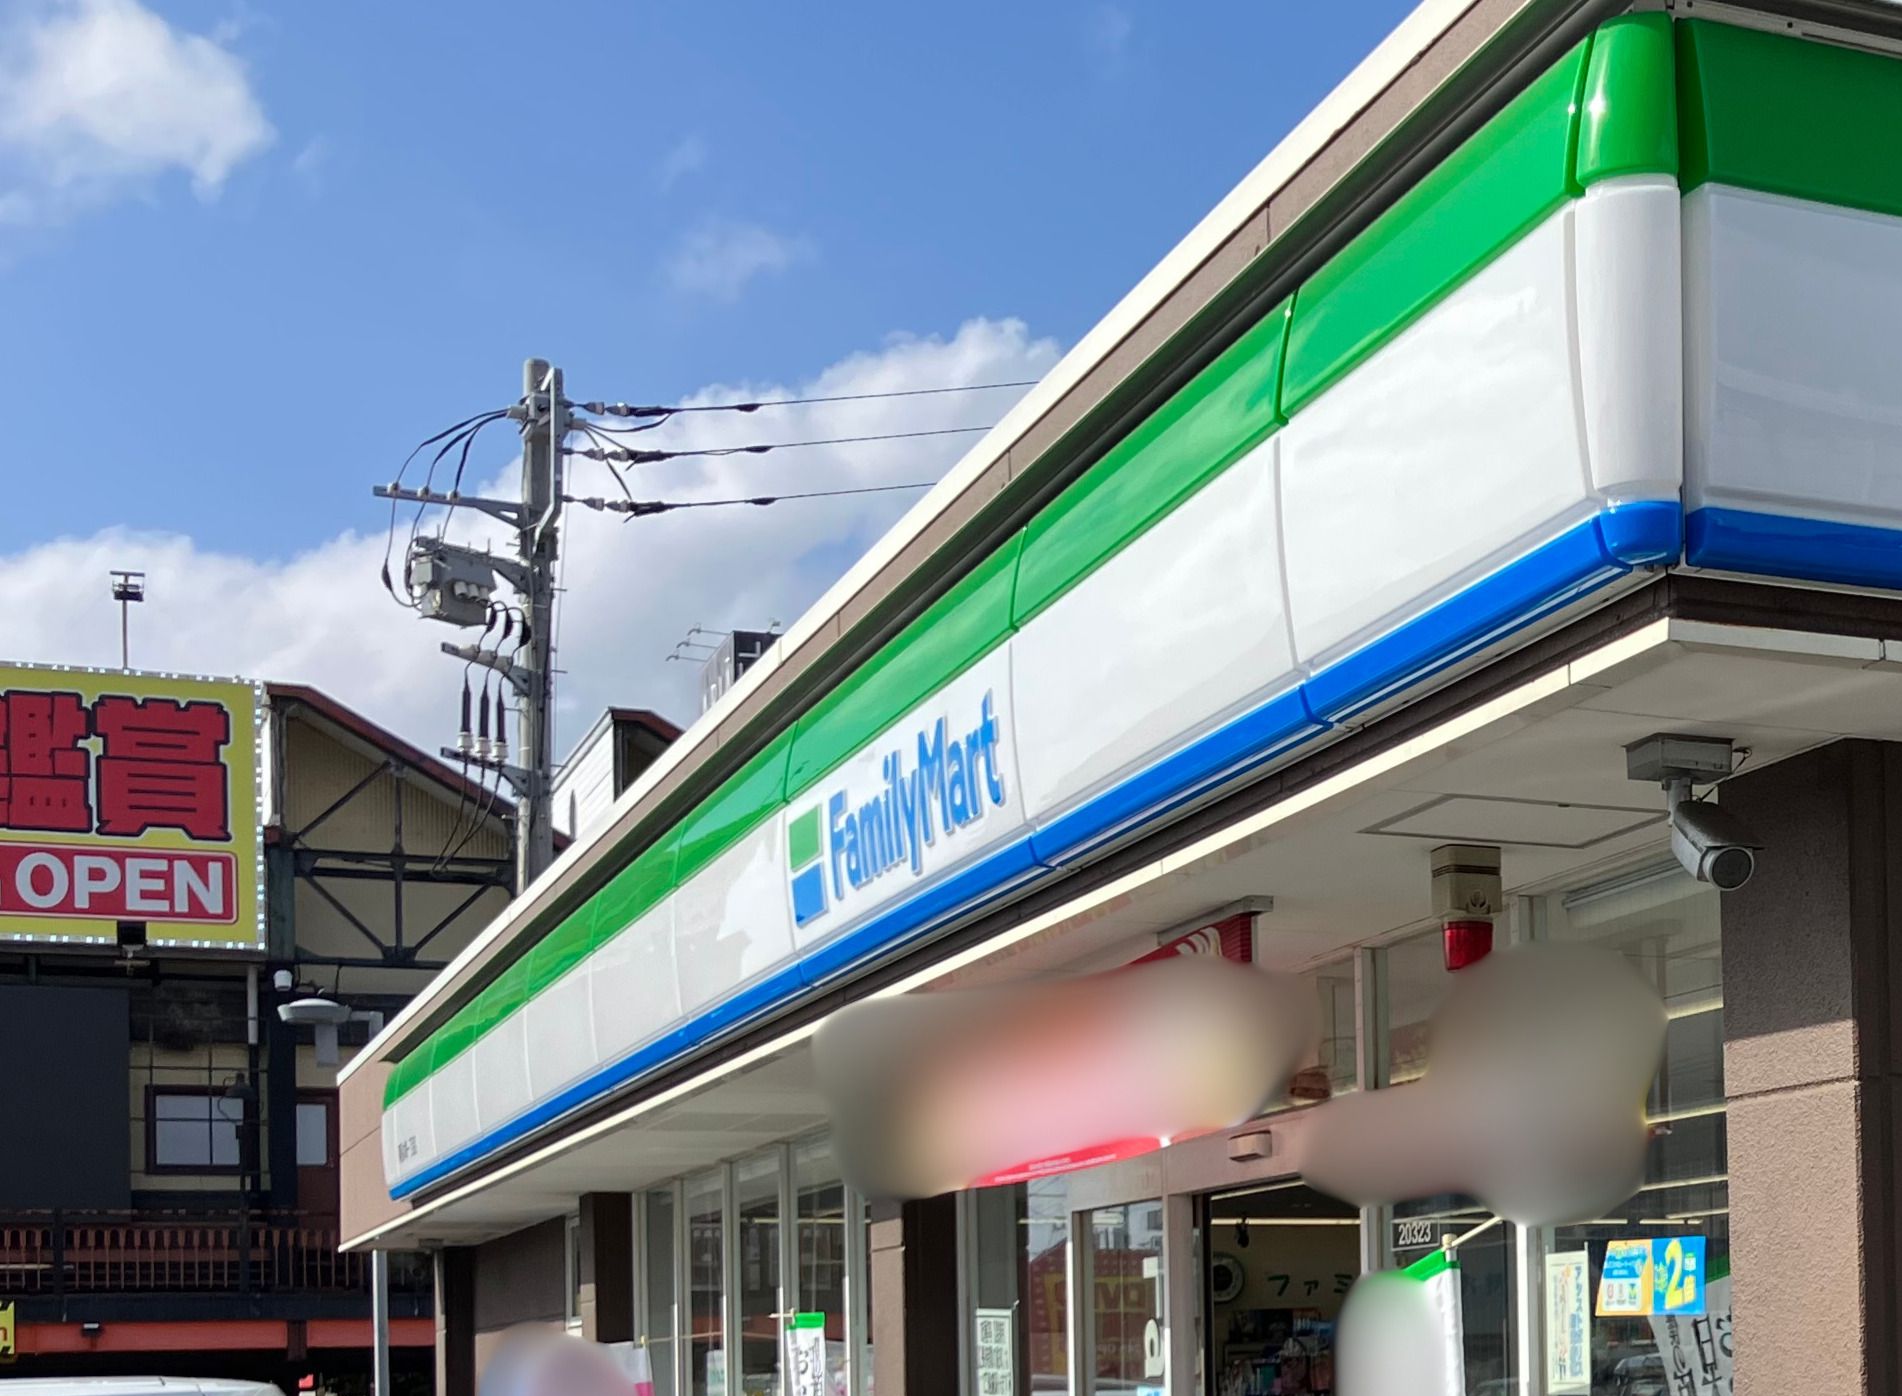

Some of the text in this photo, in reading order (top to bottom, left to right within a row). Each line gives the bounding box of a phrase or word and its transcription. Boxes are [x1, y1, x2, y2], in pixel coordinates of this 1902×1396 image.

[828, 683, 1006, 901] FamilyMart
[14, 851, 225, 915] OPEN
[1398, 1220, 1432, 1245] 20323
